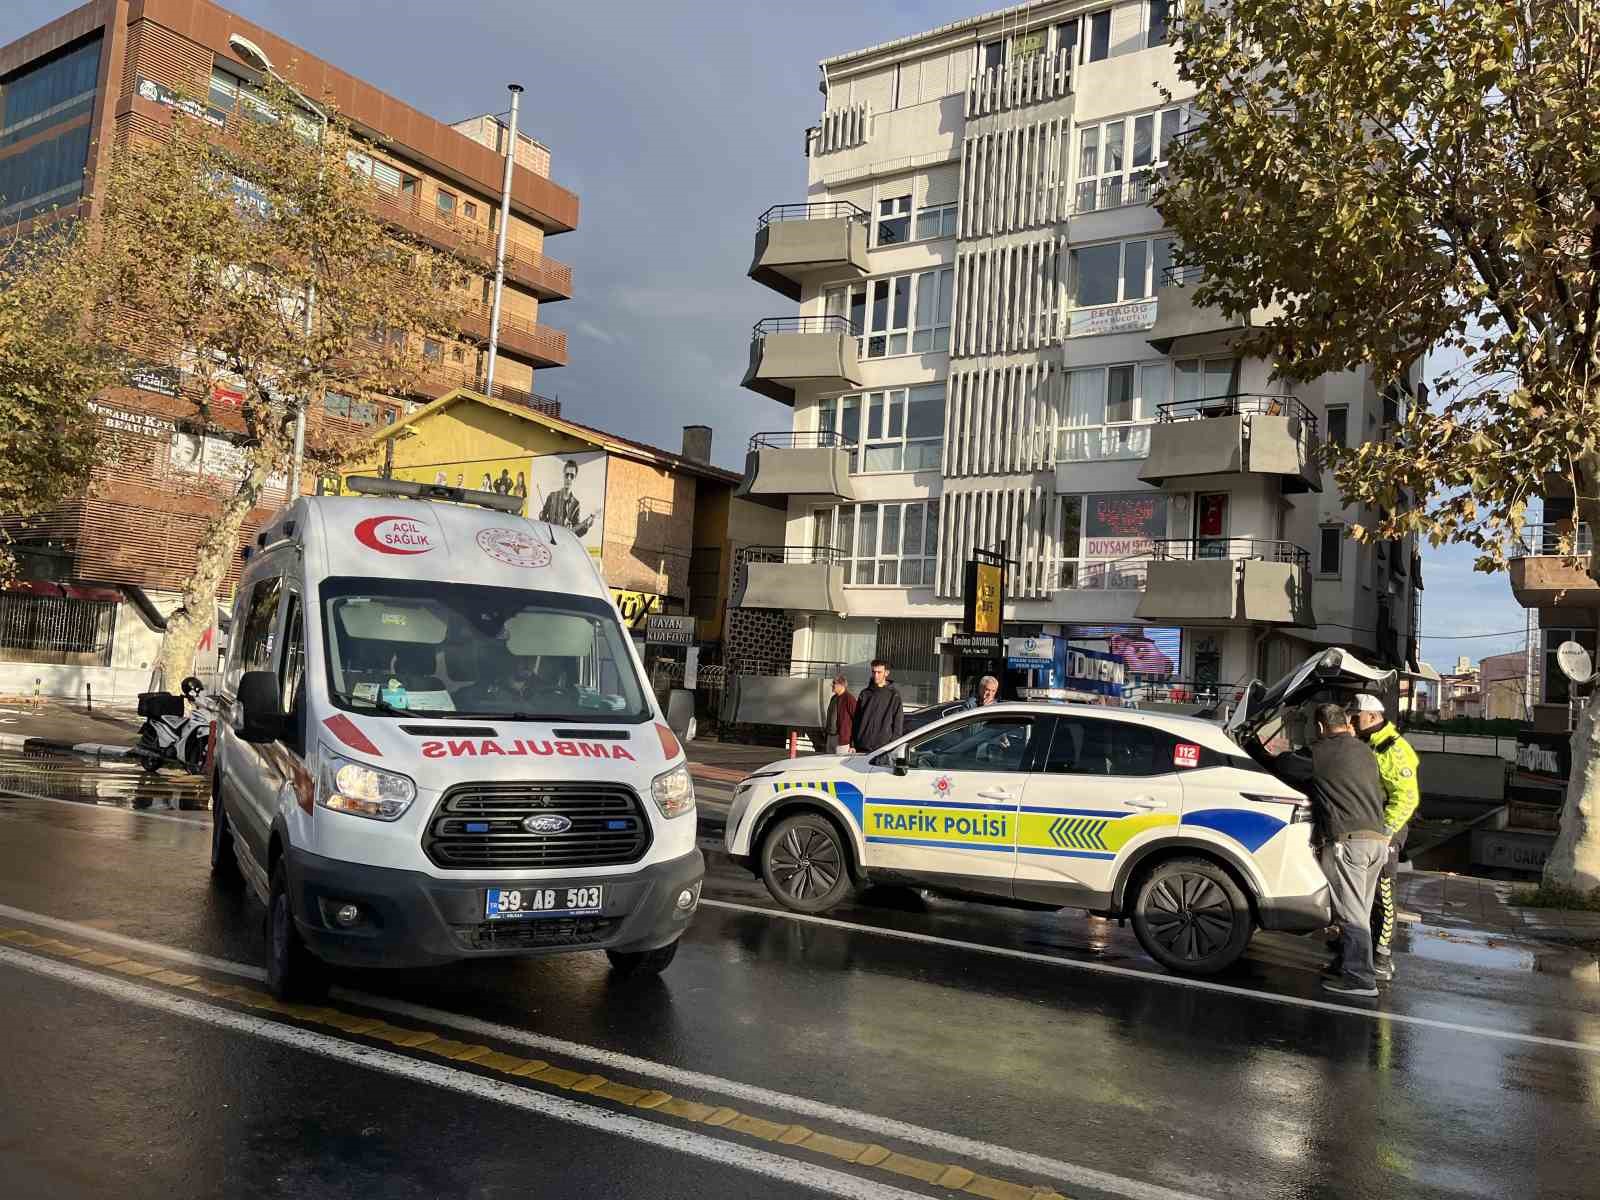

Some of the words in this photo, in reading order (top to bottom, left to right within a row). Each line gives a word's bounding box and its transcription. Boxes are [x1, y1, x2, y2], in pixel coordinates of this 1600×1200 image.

[393, 522, 420, 533] ACİL
[385, 534, 429, 545] SAĞLIK
[1089, 541, 1130, 554] DUYSAM
[1179, 746, 1196, 759] 112
[873, 810, 937, 833] TRAFİK
[944, 814, 1006, 837] POLİSİ
[498, 890, 520, 912] 59
[532, 889, 555, 910] AB
[566, 887, 598, 908] 503
